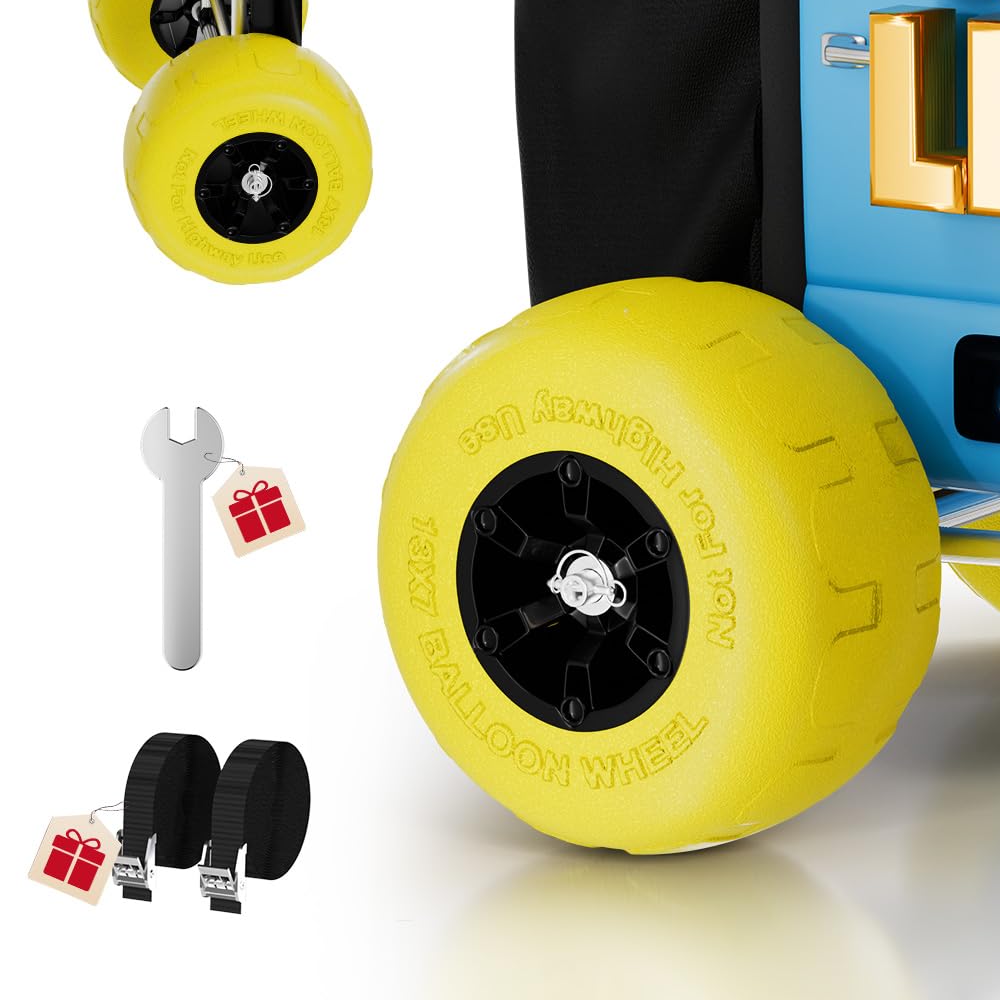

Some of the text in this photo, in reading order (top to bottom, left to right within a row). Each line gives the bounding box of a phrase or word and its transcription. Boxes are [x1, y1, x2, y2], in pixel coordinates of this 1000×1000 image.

[458, 389, 737, 650] Not For Highway Use
[418, 630, 570, 787] BALLOON
[580, 710, 709, 790] WHEEL
